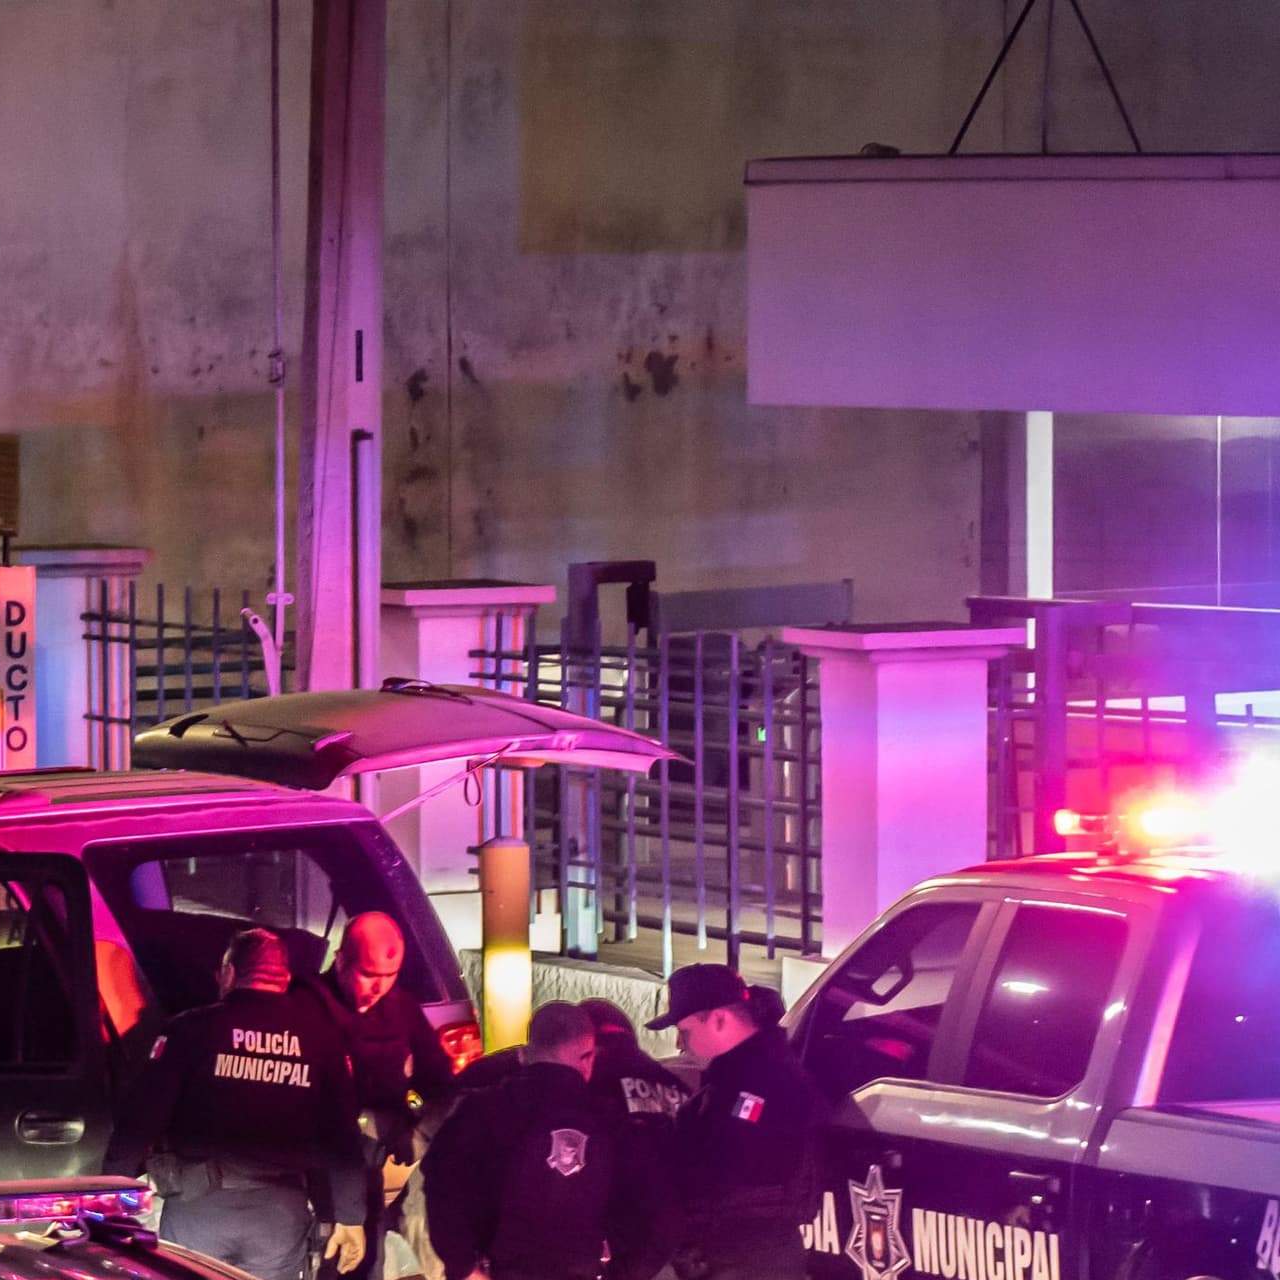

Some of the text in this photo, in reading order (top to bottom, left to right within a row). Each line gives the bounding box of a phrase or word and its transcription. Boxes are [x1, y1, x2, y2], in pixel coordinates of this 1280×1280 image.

[5, 600, 29, 752] DUCTO
[232, 1028, 302, 1057] POLICÍA
[214, 1053, 312, 1088] MUNICIPAL
